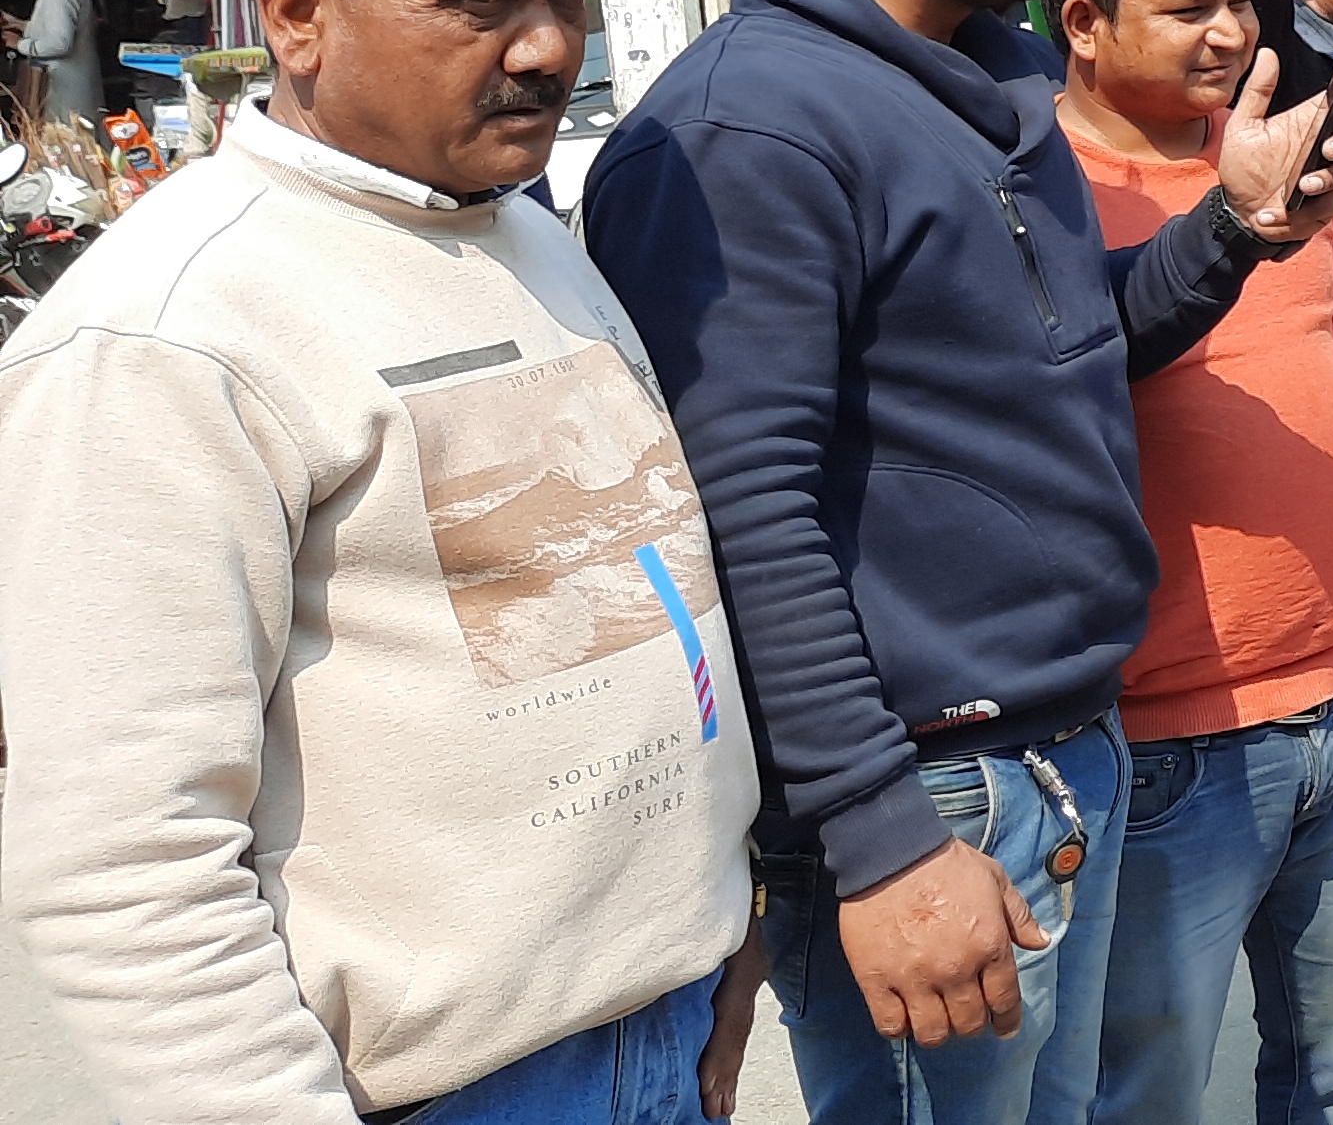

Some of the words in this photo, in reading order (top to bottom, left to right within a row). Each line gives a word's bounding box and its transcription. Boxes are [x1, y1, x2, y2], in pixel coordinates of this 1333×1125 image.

[486, 677, 613, 724] worldwide
[941, 701, 975, 720] THE
[547, 729, 684, 792] SOUTHERN
[529, 761, 686, 829] CALIFORNIA
[631, 790, 687, 827] SURF
